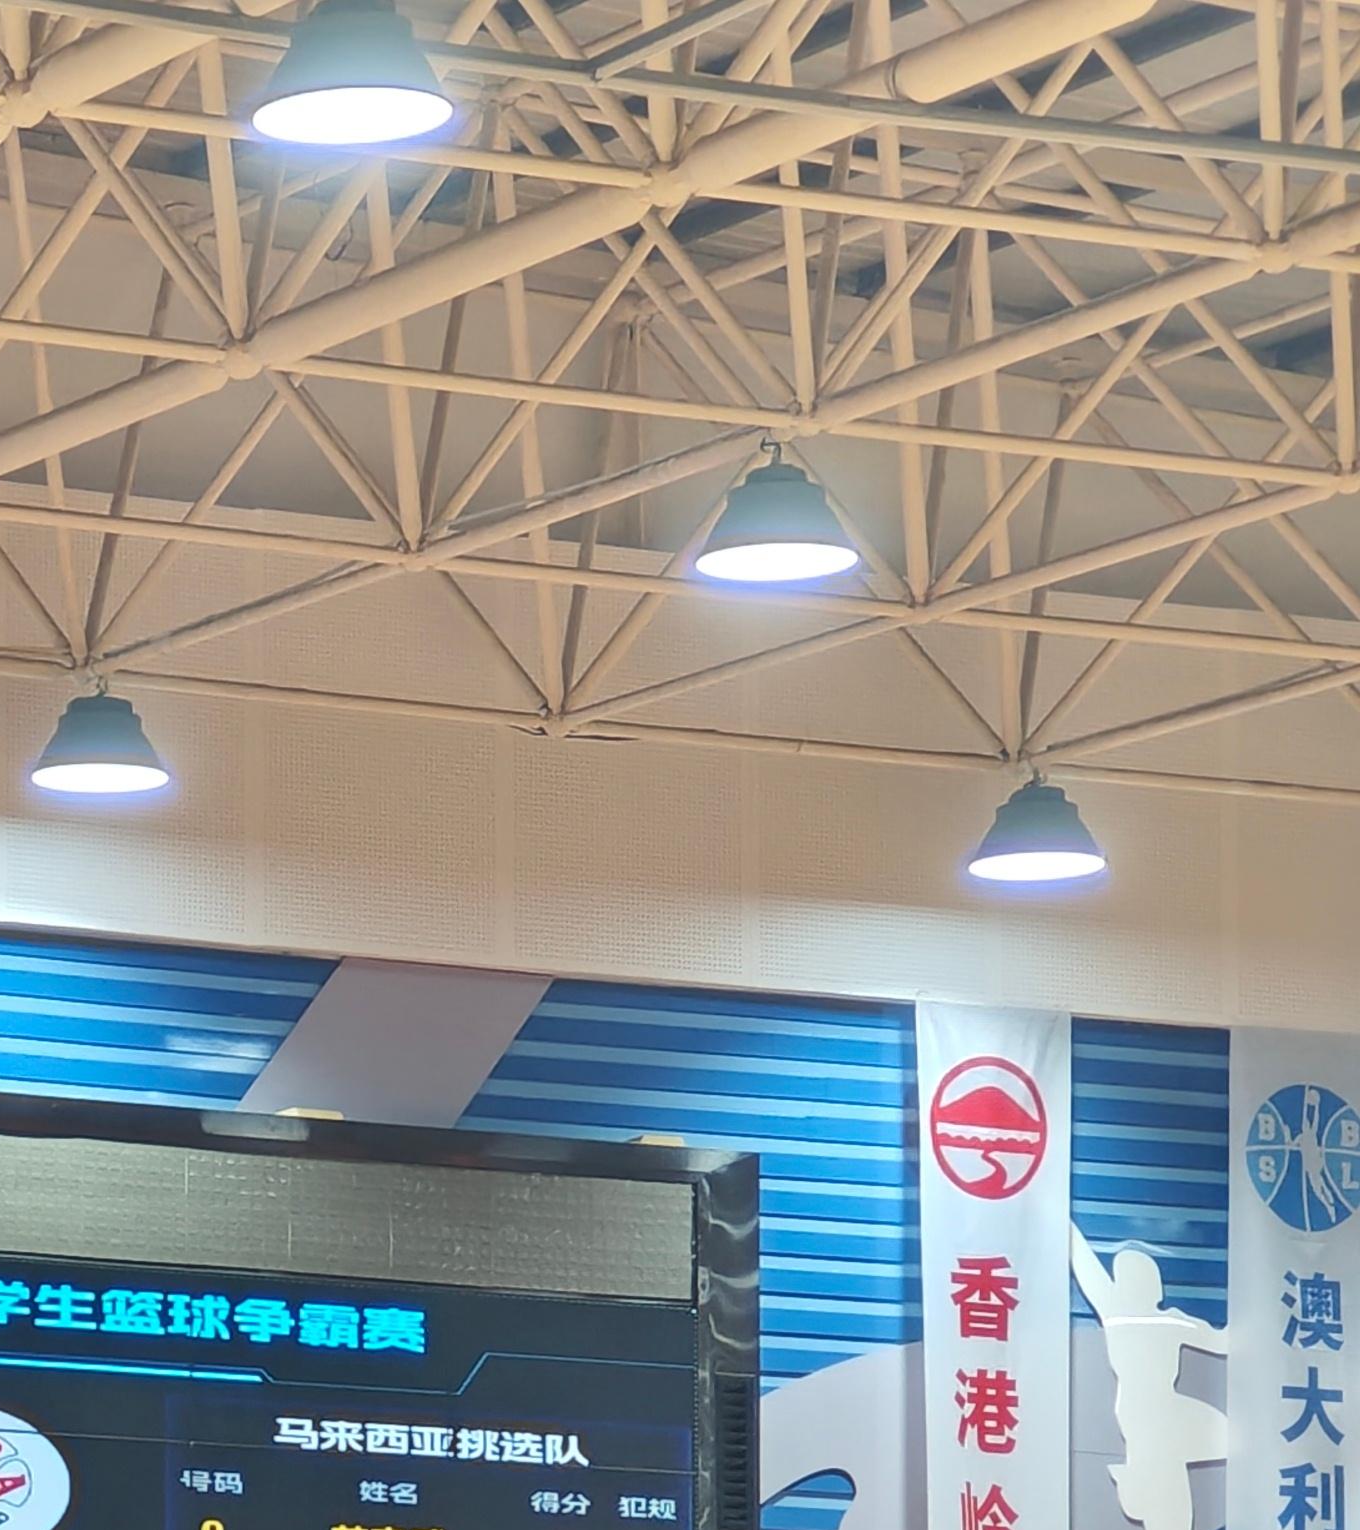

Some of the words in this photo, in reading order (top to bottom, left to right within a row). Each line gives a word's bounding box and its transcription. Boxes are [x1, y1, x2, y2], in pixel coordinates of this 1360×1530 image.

[274, 1418, 589, 1466] 马来西亚挑选队
[180, 1471, 242, 1494] 号码
[360, 1481, 417, 1504] 姓名
[531, 1492, 590, 1514] 得分
[619, 1497, 676, 1520] 犯规
